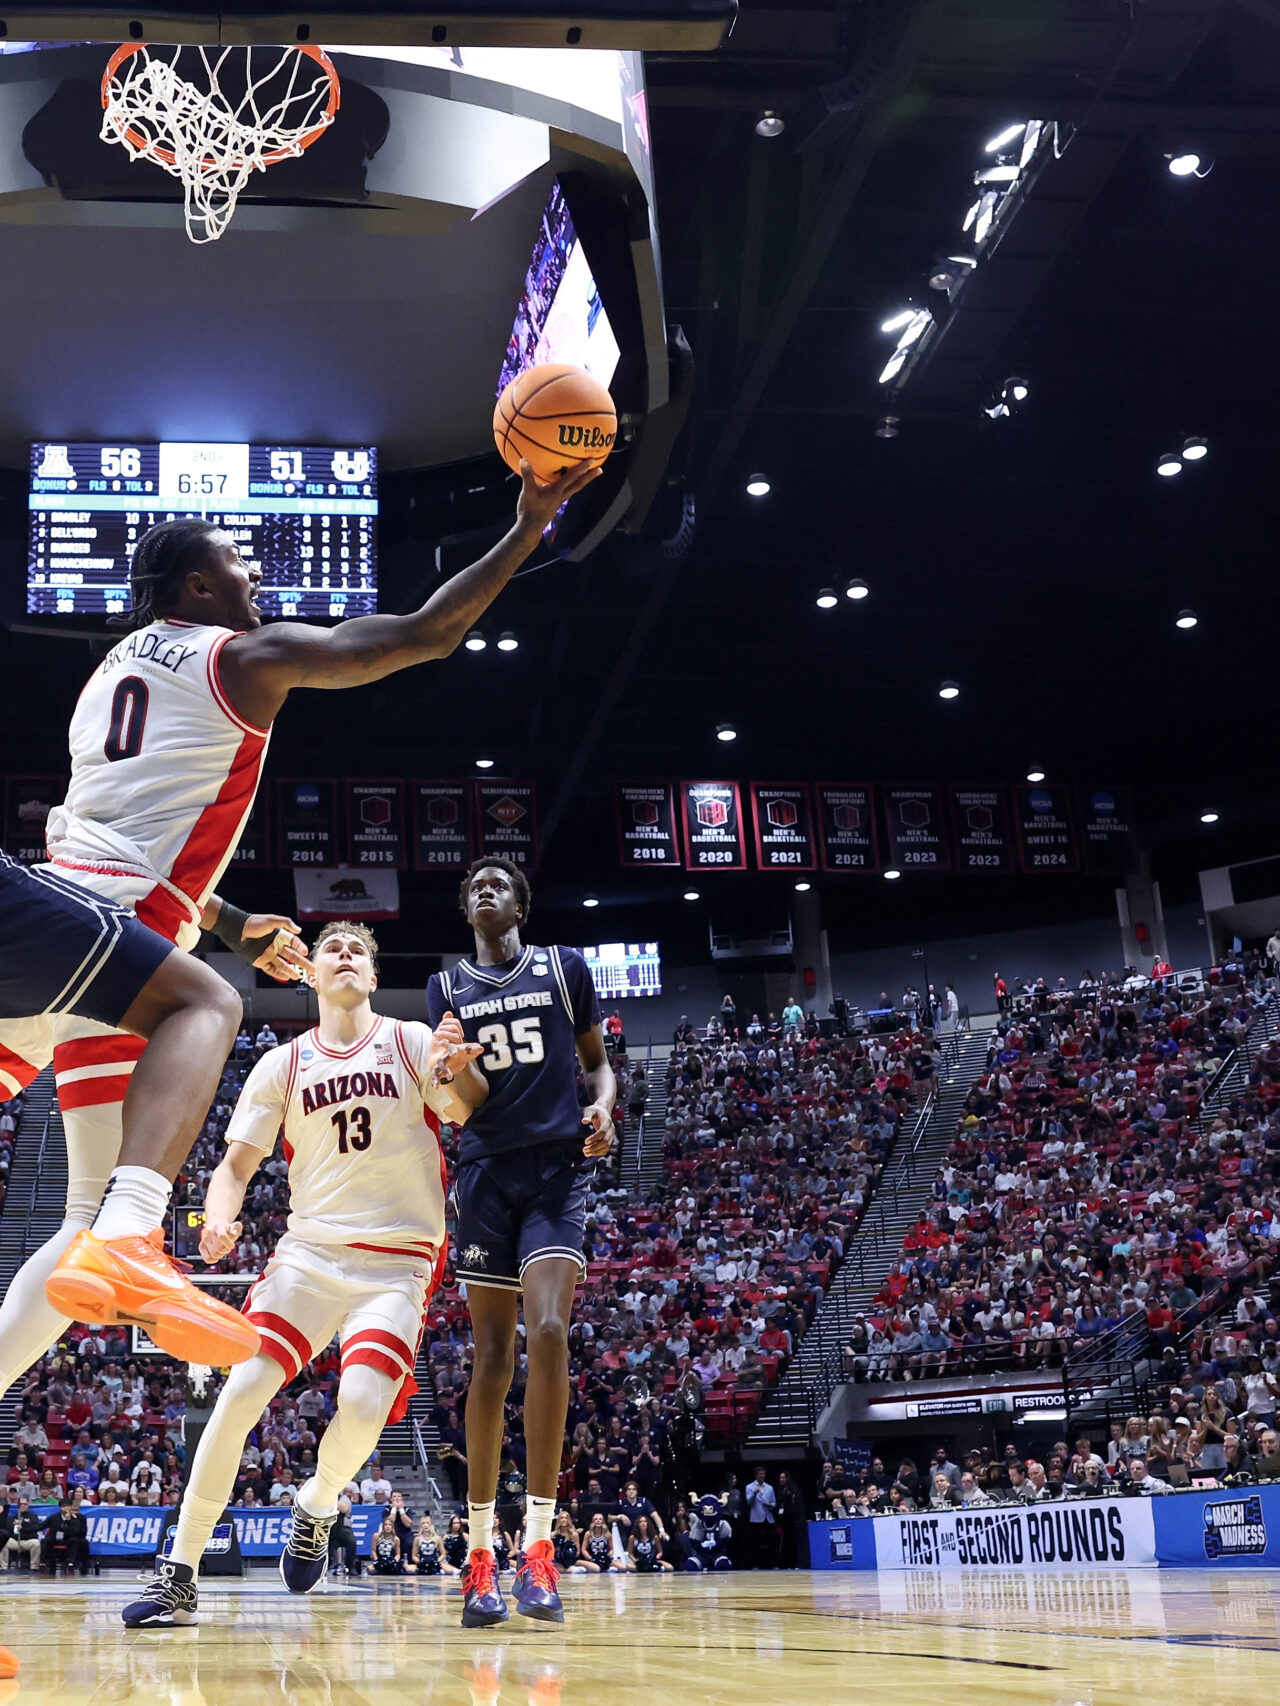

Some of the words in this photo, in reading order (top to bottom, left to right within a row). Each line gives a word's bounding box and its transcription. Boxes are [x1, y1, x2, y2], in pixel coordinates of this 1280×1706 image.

[101, 448, 140, 477] 56
[270, 451, 306, 481] 51
[33, 480, 66, 490] BONUS
[89, 480, 107, 490] FLS
[125, 480, 143, 491] TOL
[178, 474, 228, 494] 6:57
[250, 483, 283, 493] BONUS
[306, 485, 323, 494] FLS
[342, 485, 359, 495] TOL
[126, 512, 140, 524] 10
[224, 515, 262, 525] COLLINS
[342, 516, 348, 528] 1
[360, 517, 368, 528] 2
[322, 531, 330, 542] 2
[342, 532, 348, 542] 1
[360, 532, 368, 543] 3
[341, 547, 349, 558] 0
[360, 547, 368, 558] 2
[342, 577, 348, 588] 1
[360, 578, 366, 588] 1
[103, 633, 198, 674] BRADLEY
[104, 675, 149, 762] 0
[625, 832, 670, 840] BASKETBALL
[233, 850, 256, 860] 014
[292, 850, 324, 862] 2014
[360, 850, 394, 862] 2015
[633, 848, 666, 859] 2018
[698, 852, 733, 863] 2020
[770, 852, 802, 863] 2021
[835, 854, 864, 865] 2021
[904, 852, 936, 862] 2023
[1034, 854, 1067, 864] 2024
[969, 855, 1000, 866] 2023
[459, 998, 504, 1020] UTAH
[504, 991, 553, 1012] STATE
[477, 1016, 545, 1071] 35
[302, 1071, 400, 1116] ARIZONA
[330, 1106, 372, 1154] 13
[989, 1400, 1003, 1411] EXIT
[1212, 1504, 1244, 1526] MARCH
[900, 1520, 940, 1564] FIRST
[941, 1532, 956, 1551] AND
[956, 1514, 1024, 1564] SECOND
[1027, 1506, 1124, 1563] ROUNDS
[1219, 1524, 1265, 1546] MADNESS
